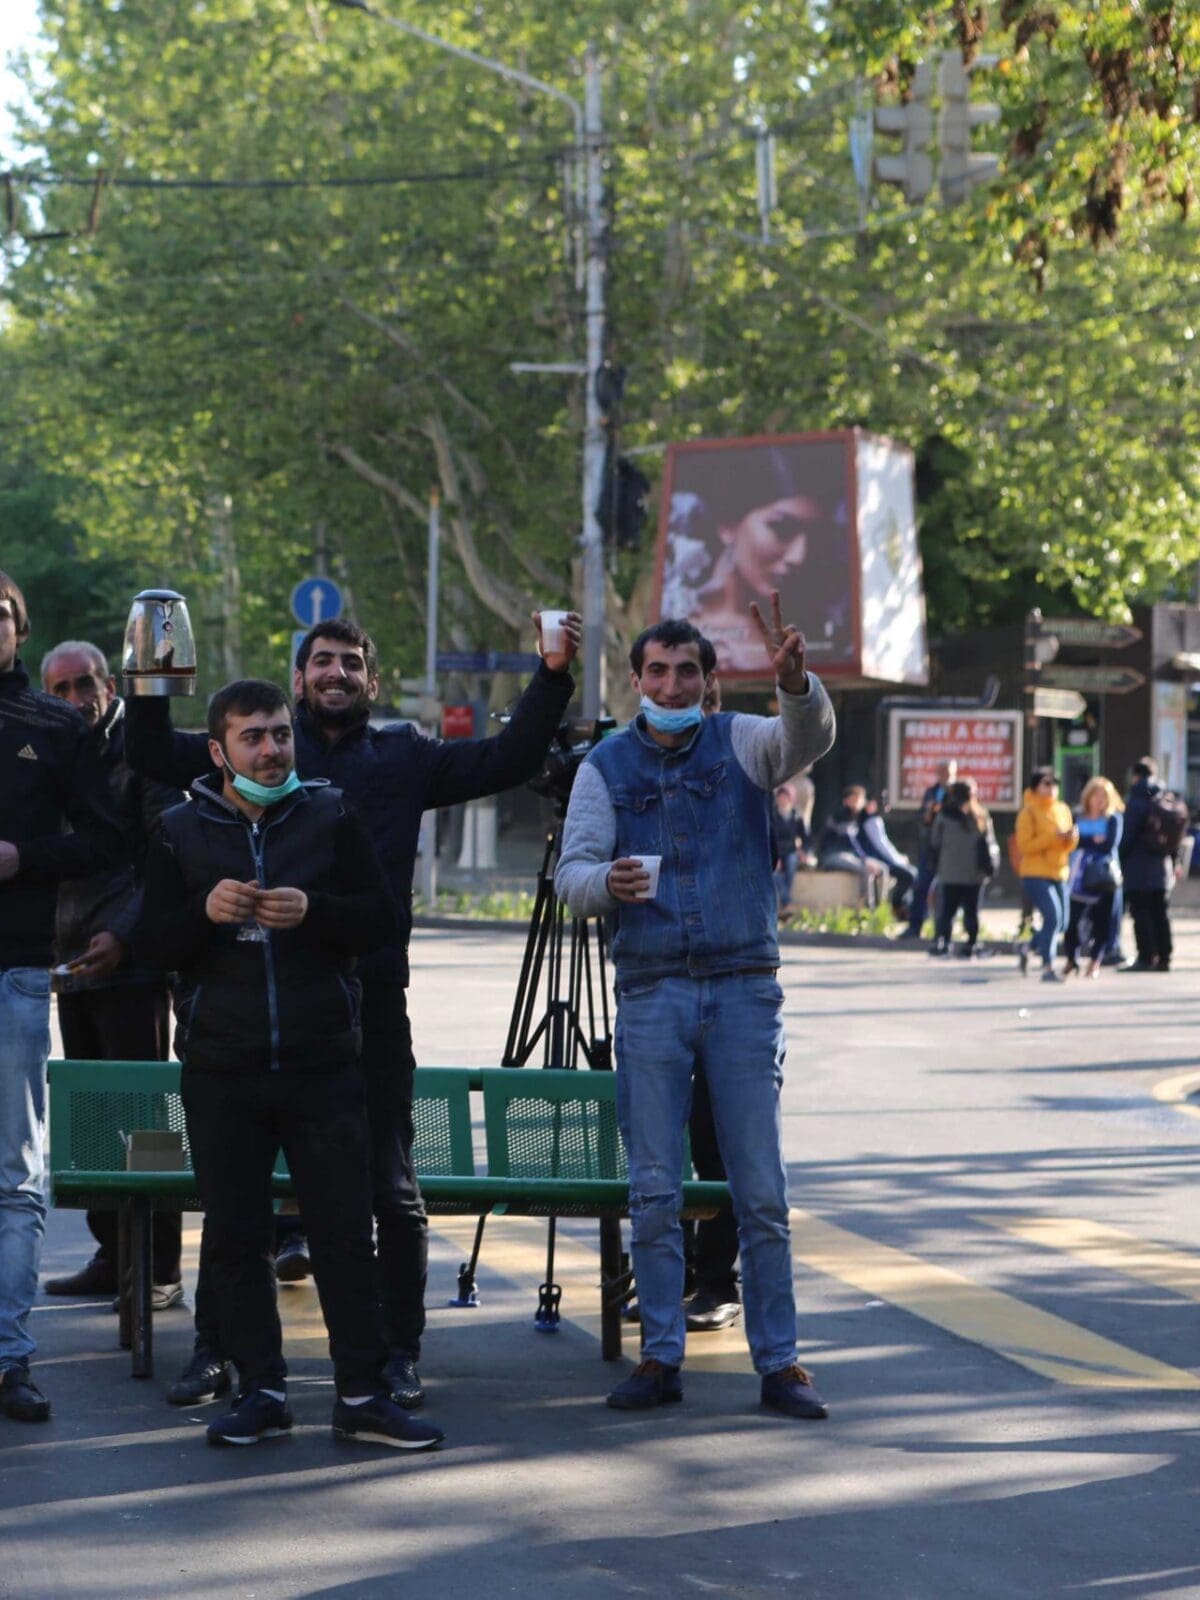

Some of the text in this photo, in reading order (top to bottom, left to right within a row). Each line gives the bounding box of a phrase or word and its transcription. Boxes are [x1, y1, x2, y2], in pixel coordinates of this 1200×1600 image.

[905, 721, 1011, 739] RENT A CAR
